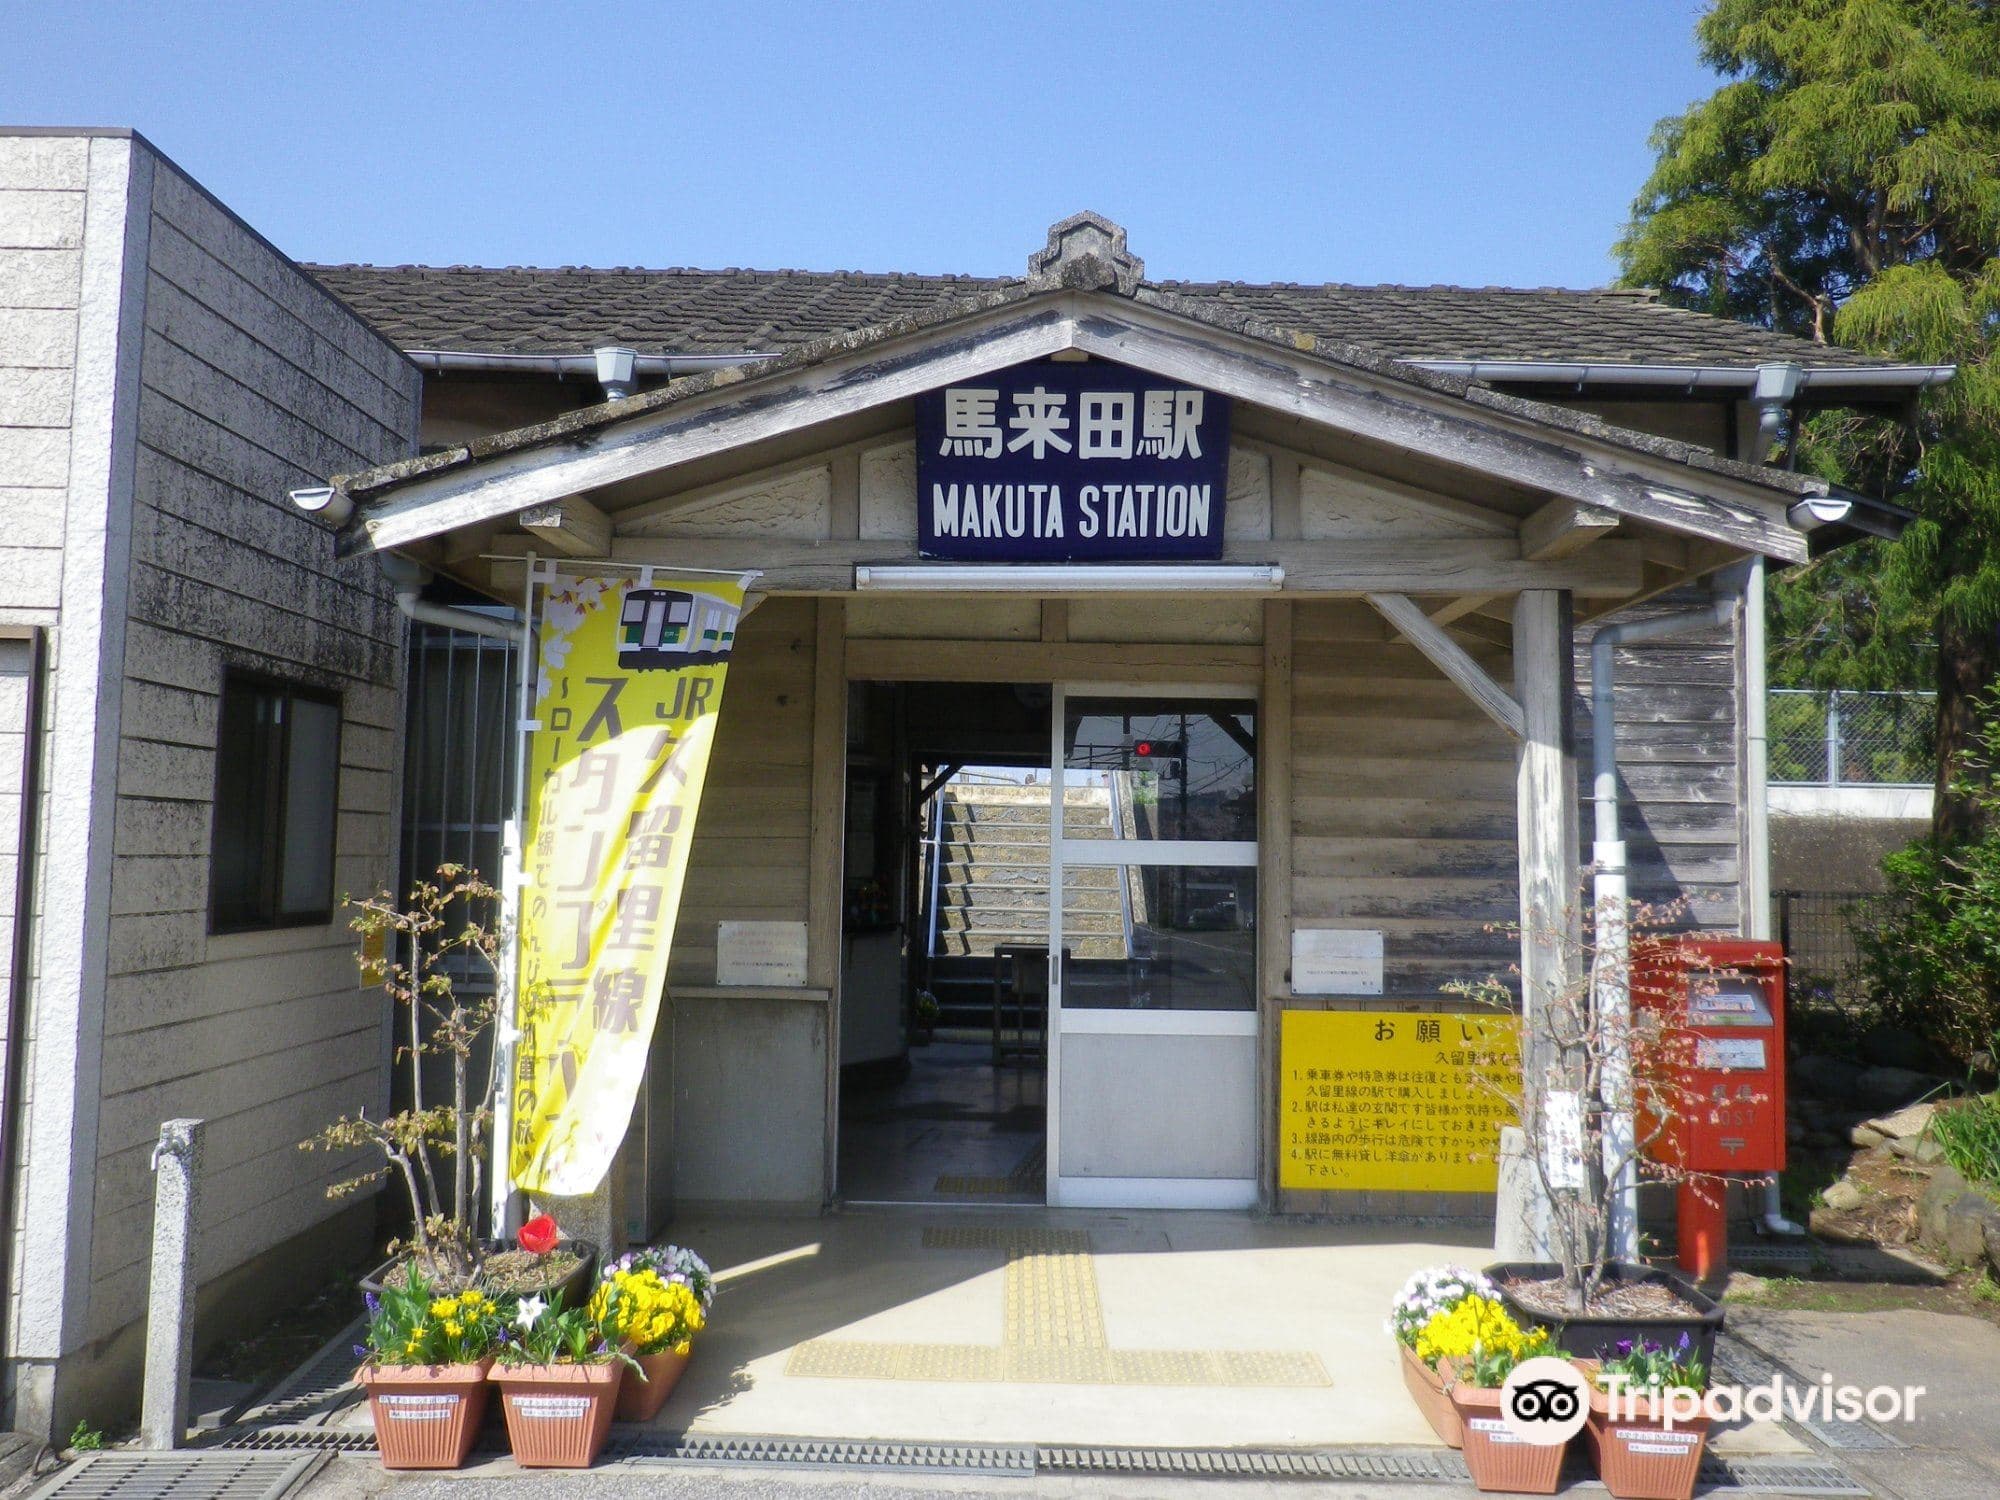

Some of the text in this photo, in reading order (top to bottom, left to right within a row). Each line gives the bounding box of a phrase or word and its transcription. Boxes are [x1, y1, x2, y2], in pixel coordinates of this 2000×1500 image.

[939, 386, 1205, 460] 馬来田駅
[933, 484, 1211, 538] MAKUTA STATION
[1374, 1019, 1486, 1044] お願い
[1709, 1110, 1755, 1126] OST
[1305, 1164, 1351, 1178] 下さい。
